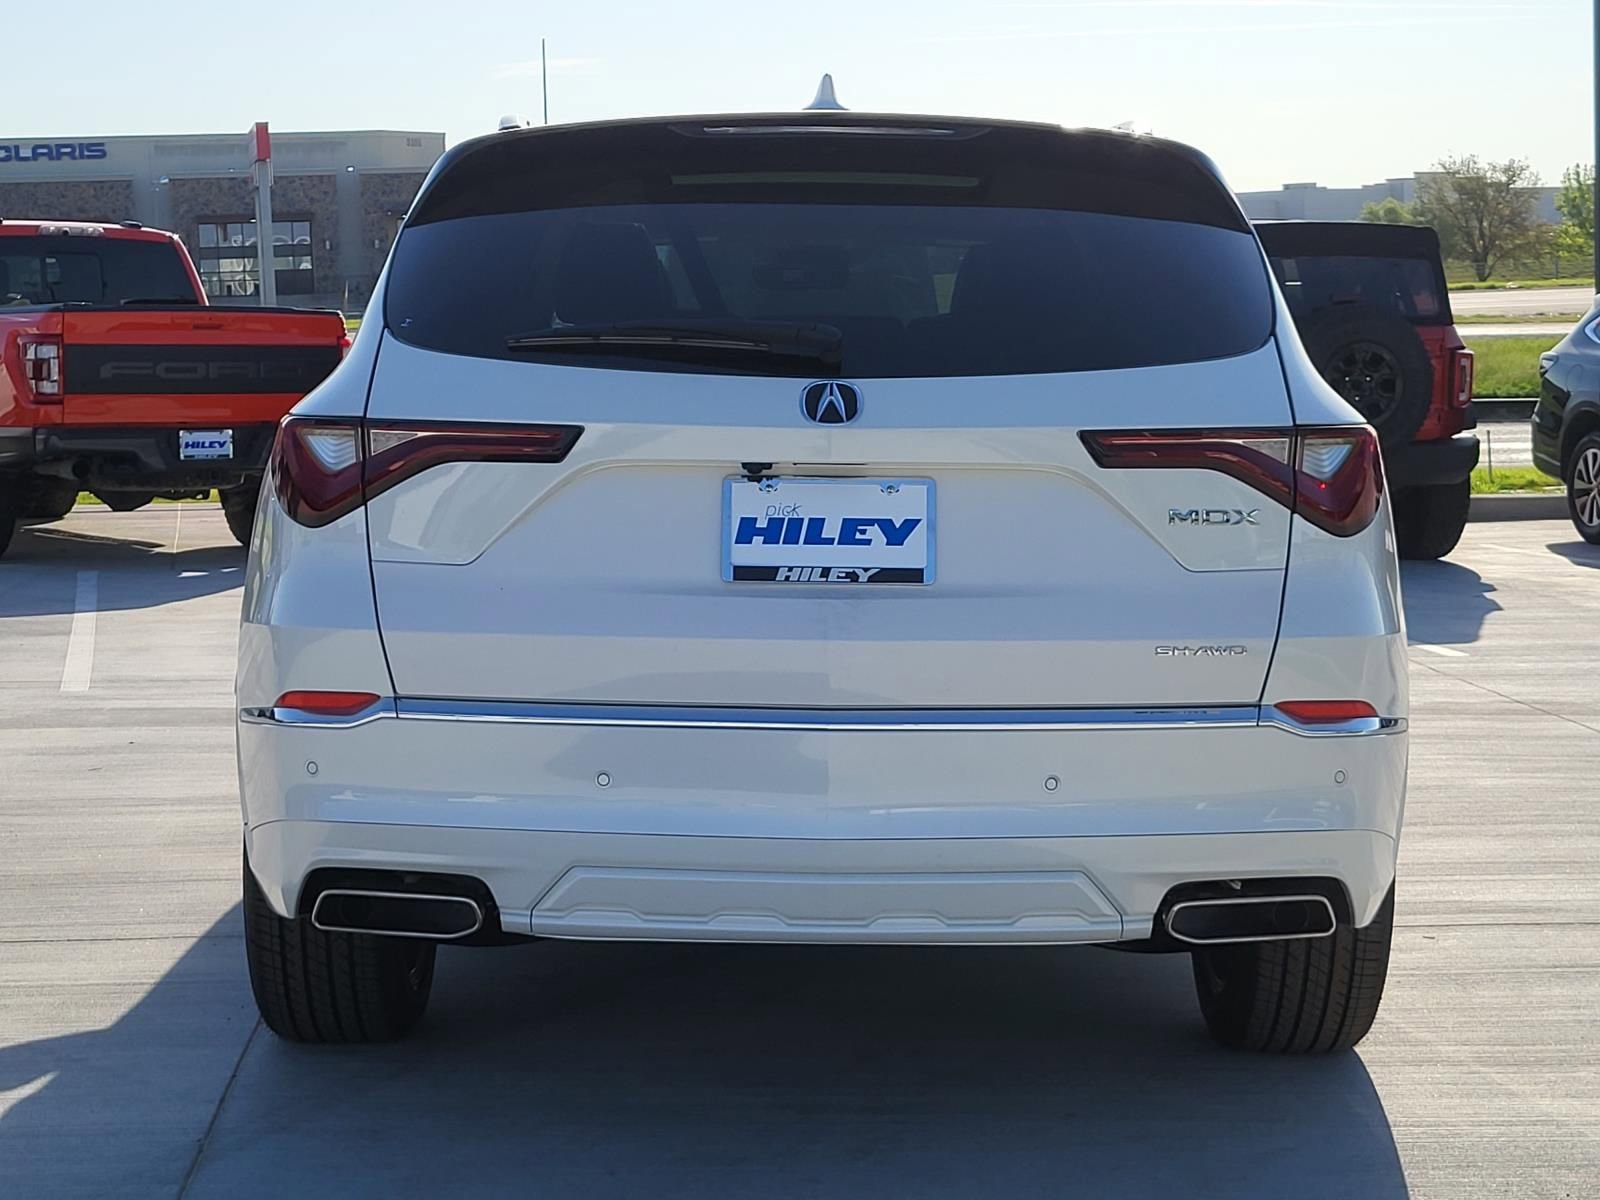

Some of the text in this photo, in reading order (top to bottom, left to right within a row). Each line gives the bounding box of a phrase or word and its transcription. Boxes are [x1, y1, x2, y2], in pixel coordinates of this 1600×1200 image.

[765, 503, 802, 519] pick
[1168, 509, 1260, 526] MDX
[734, 516, 922, 546] HILEY
[776, 567, 881, 582] HILEY
